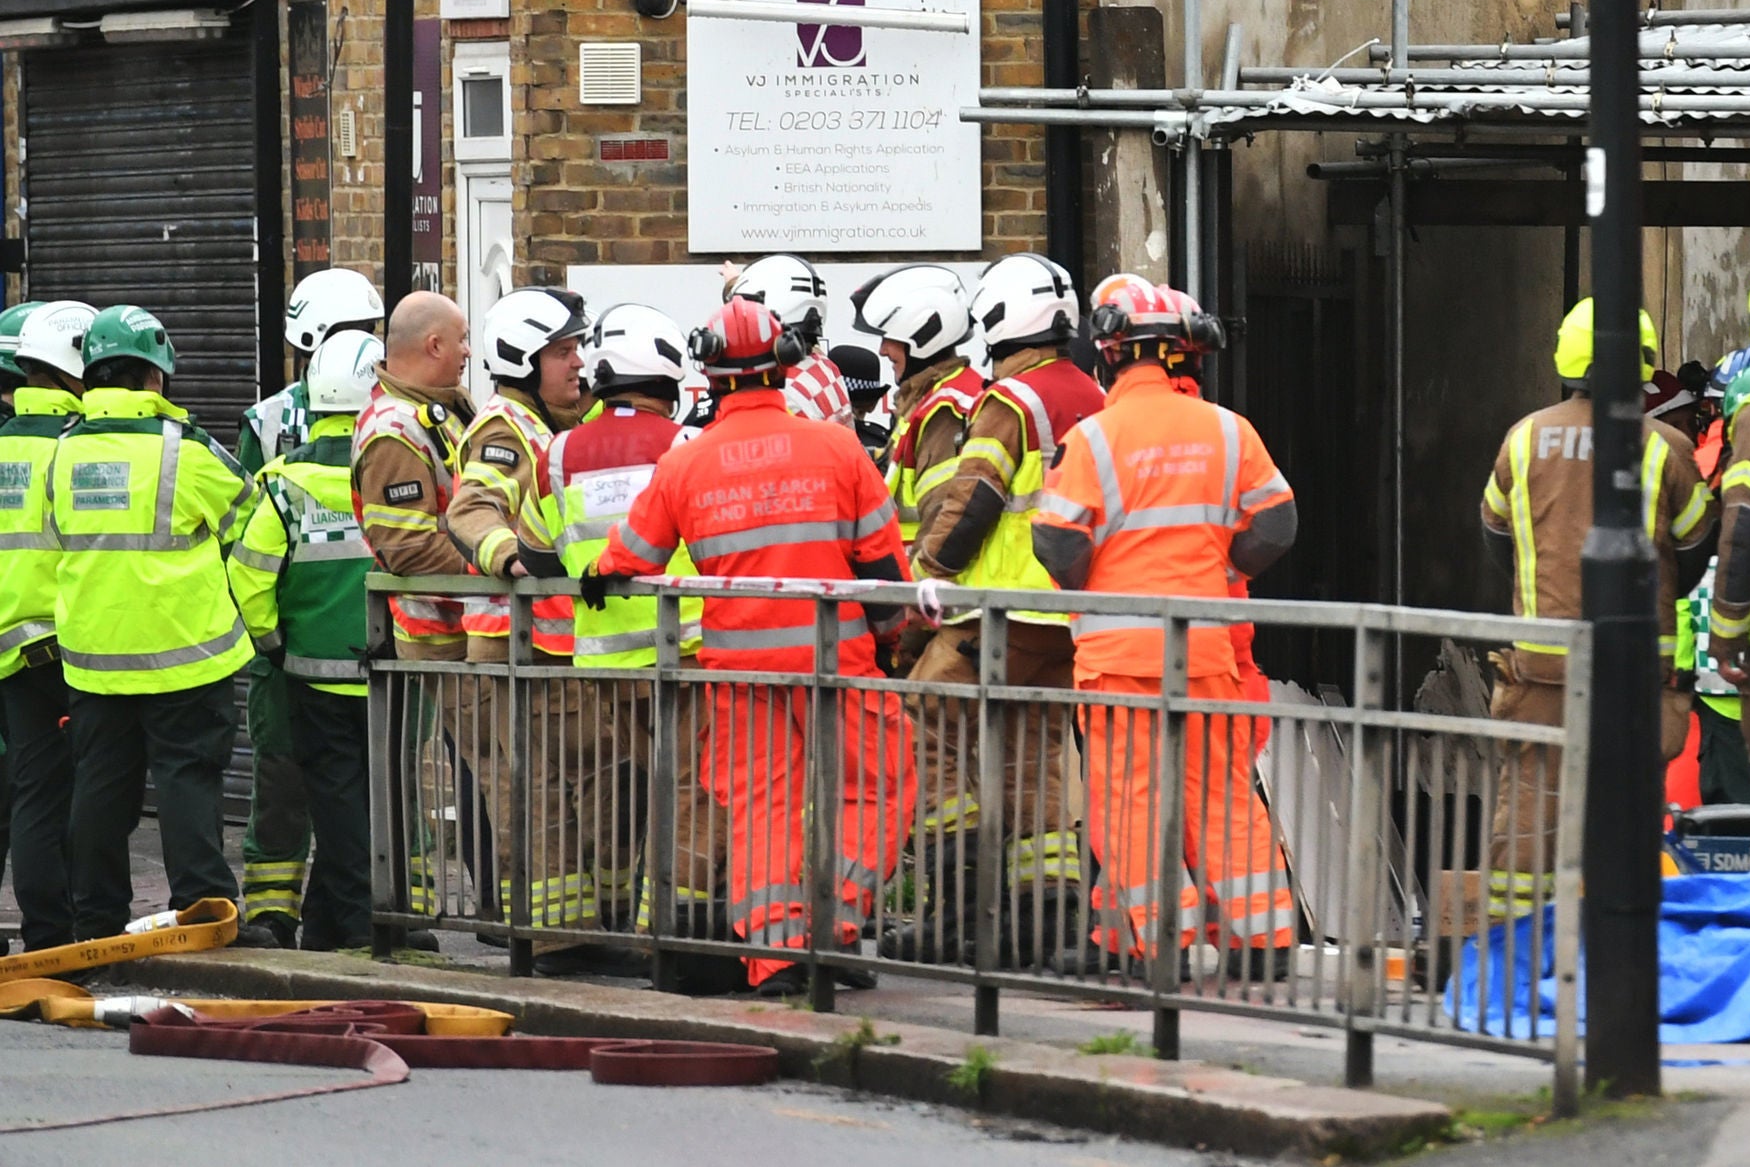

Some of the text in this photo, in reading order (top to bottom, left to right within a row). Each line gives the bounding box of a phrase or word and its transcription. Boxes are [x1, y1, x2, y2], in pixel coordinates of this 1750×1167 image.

[746, 74, 919, 86] VJ IMMIGRATION
[785, 88, 881, 98] SPECIALISTS
[726, 110, 940, 130] TEL: 0203 371 1104
[724, 144, 769, 156] Asylum
[786, 144, 830, 155] Human
[835, 144, 872, 158] Rights
[785, 163, 890, 175] EEA Applications
[784, 182, 891, 196] British Nationality
[743, 202, 816, 216] Immigration
[833, 201, 879, 213] Asylum
[882, 200, 932, 213] Appeals
[741, 225, 926, 243] www.vjimmigration.co.uk
[75, 496, 127, 504] PARAMEDIC
[696, 479, 826, 509] URBAN SEARCH
[712, 496, 814, 522] AND RESCUE
[311, 512, 353, 524] LIAISON
